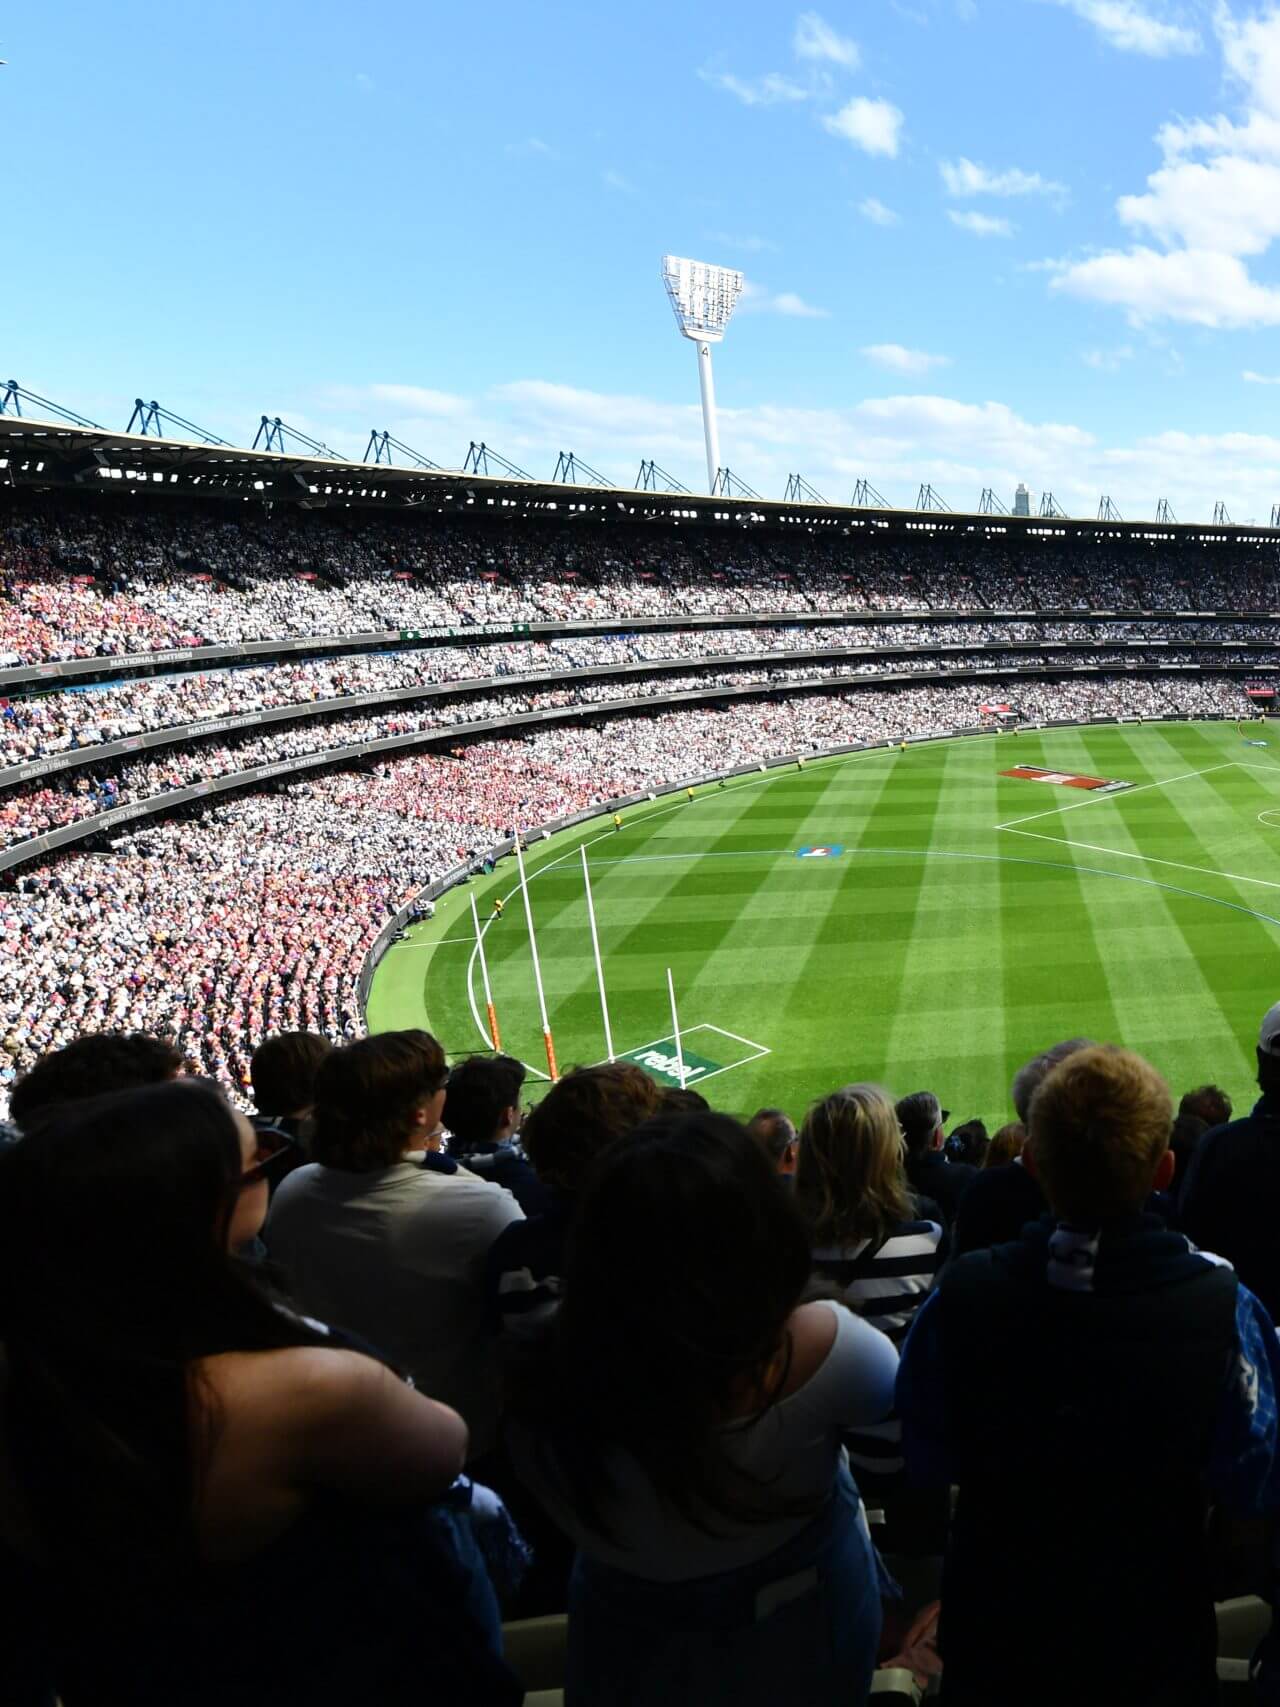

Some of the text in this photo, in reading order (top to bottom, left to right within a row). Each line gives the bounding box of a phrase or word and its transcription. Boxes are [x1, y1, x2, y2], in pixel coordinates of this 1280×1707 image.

[702, 347, 709, 358] 4
[420, 628, 450, 639] SHANE
[485, 624, 514, 636] STAND
[110, 651, 193, 667] NATIONAL ANTHEM
[187, 714, 262, 736] NATIONAL ANTHEM
[256, 754, 327, 778] NATIONAL ANTHEM
[633, 1050, 706, 1080] rebel
